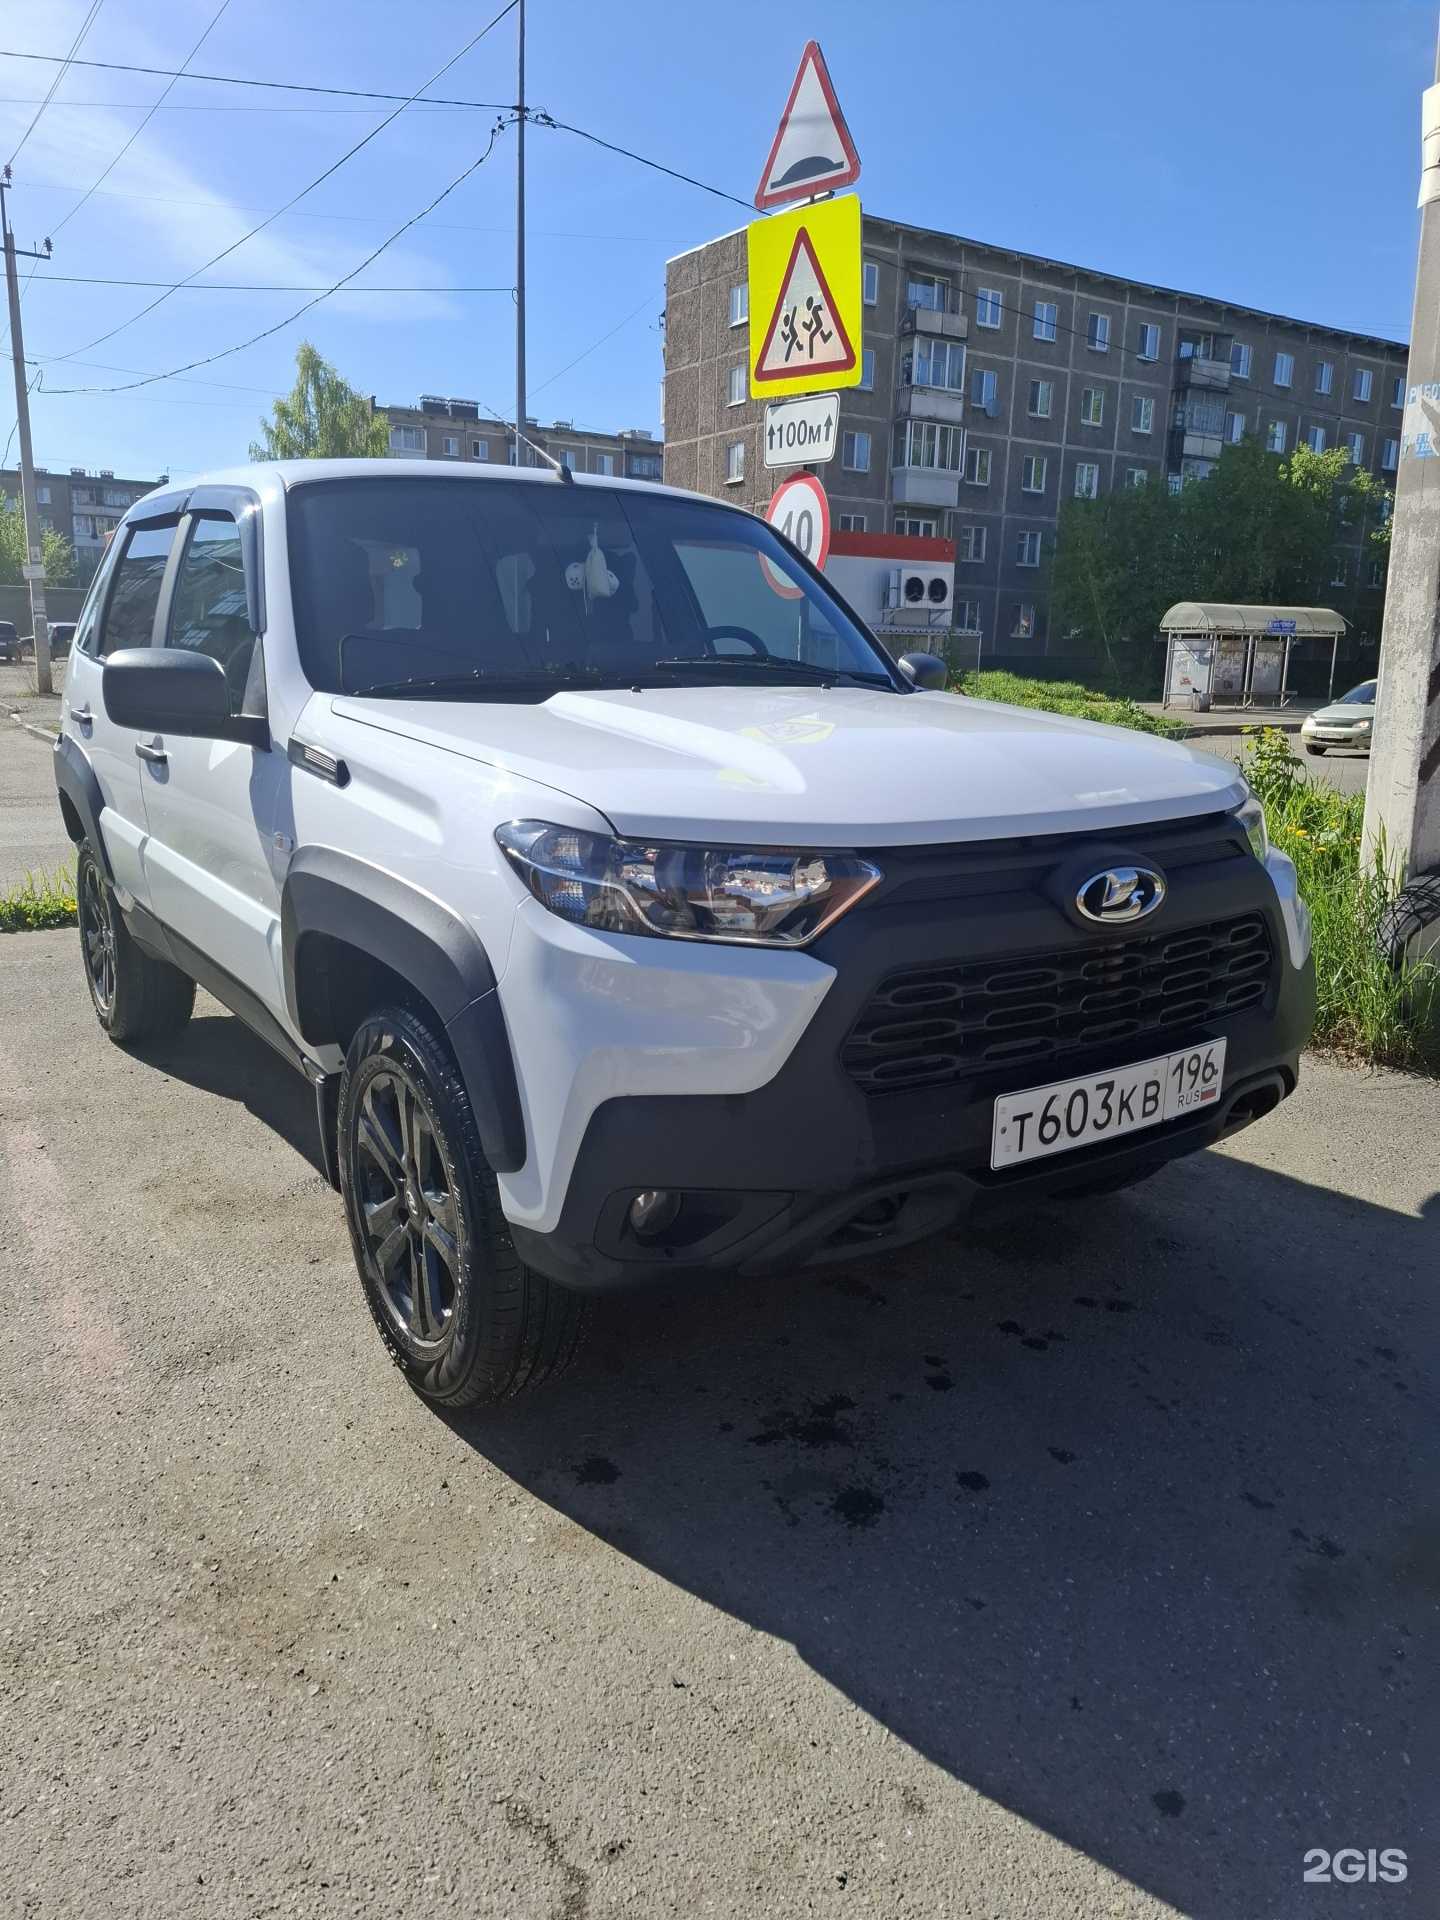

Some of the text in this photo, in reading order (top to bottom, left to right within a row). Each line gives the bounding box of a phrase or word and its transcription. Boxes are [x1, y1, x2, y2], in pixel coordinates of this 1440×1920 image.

[781, 510, 813, 557] 40
[1012, 1048, 1218, 1153] Т603КВ 196
[1177, 1093, 1201, 1109] RUS
